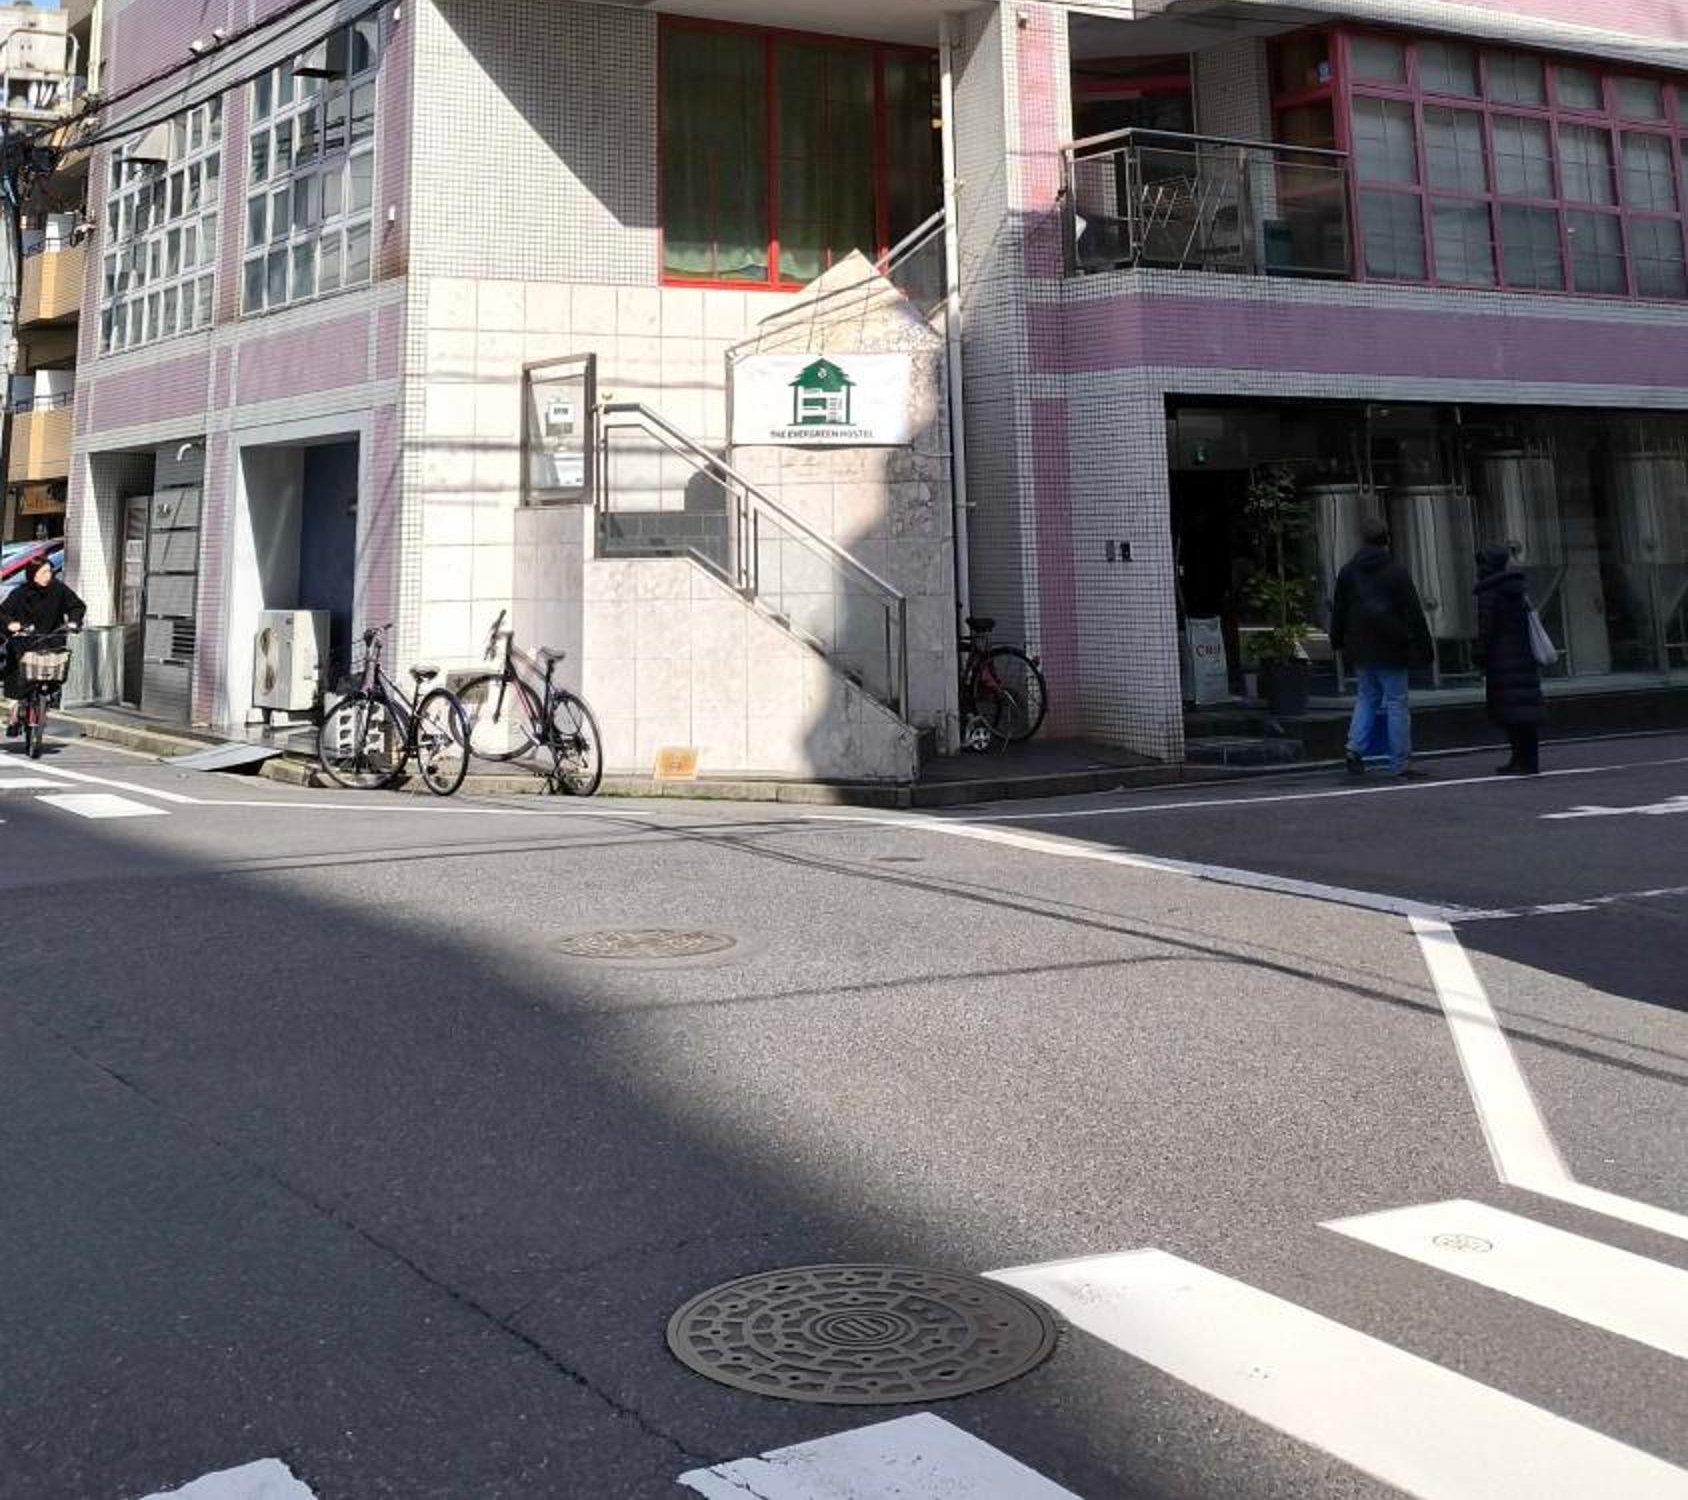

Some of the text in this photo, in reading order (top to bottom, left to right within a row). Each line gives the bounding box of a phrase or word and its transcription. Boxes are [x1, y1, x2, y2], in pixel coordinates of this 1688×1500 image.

[770, 429, 873, 438] THE EVERGREEN HOSTEL
